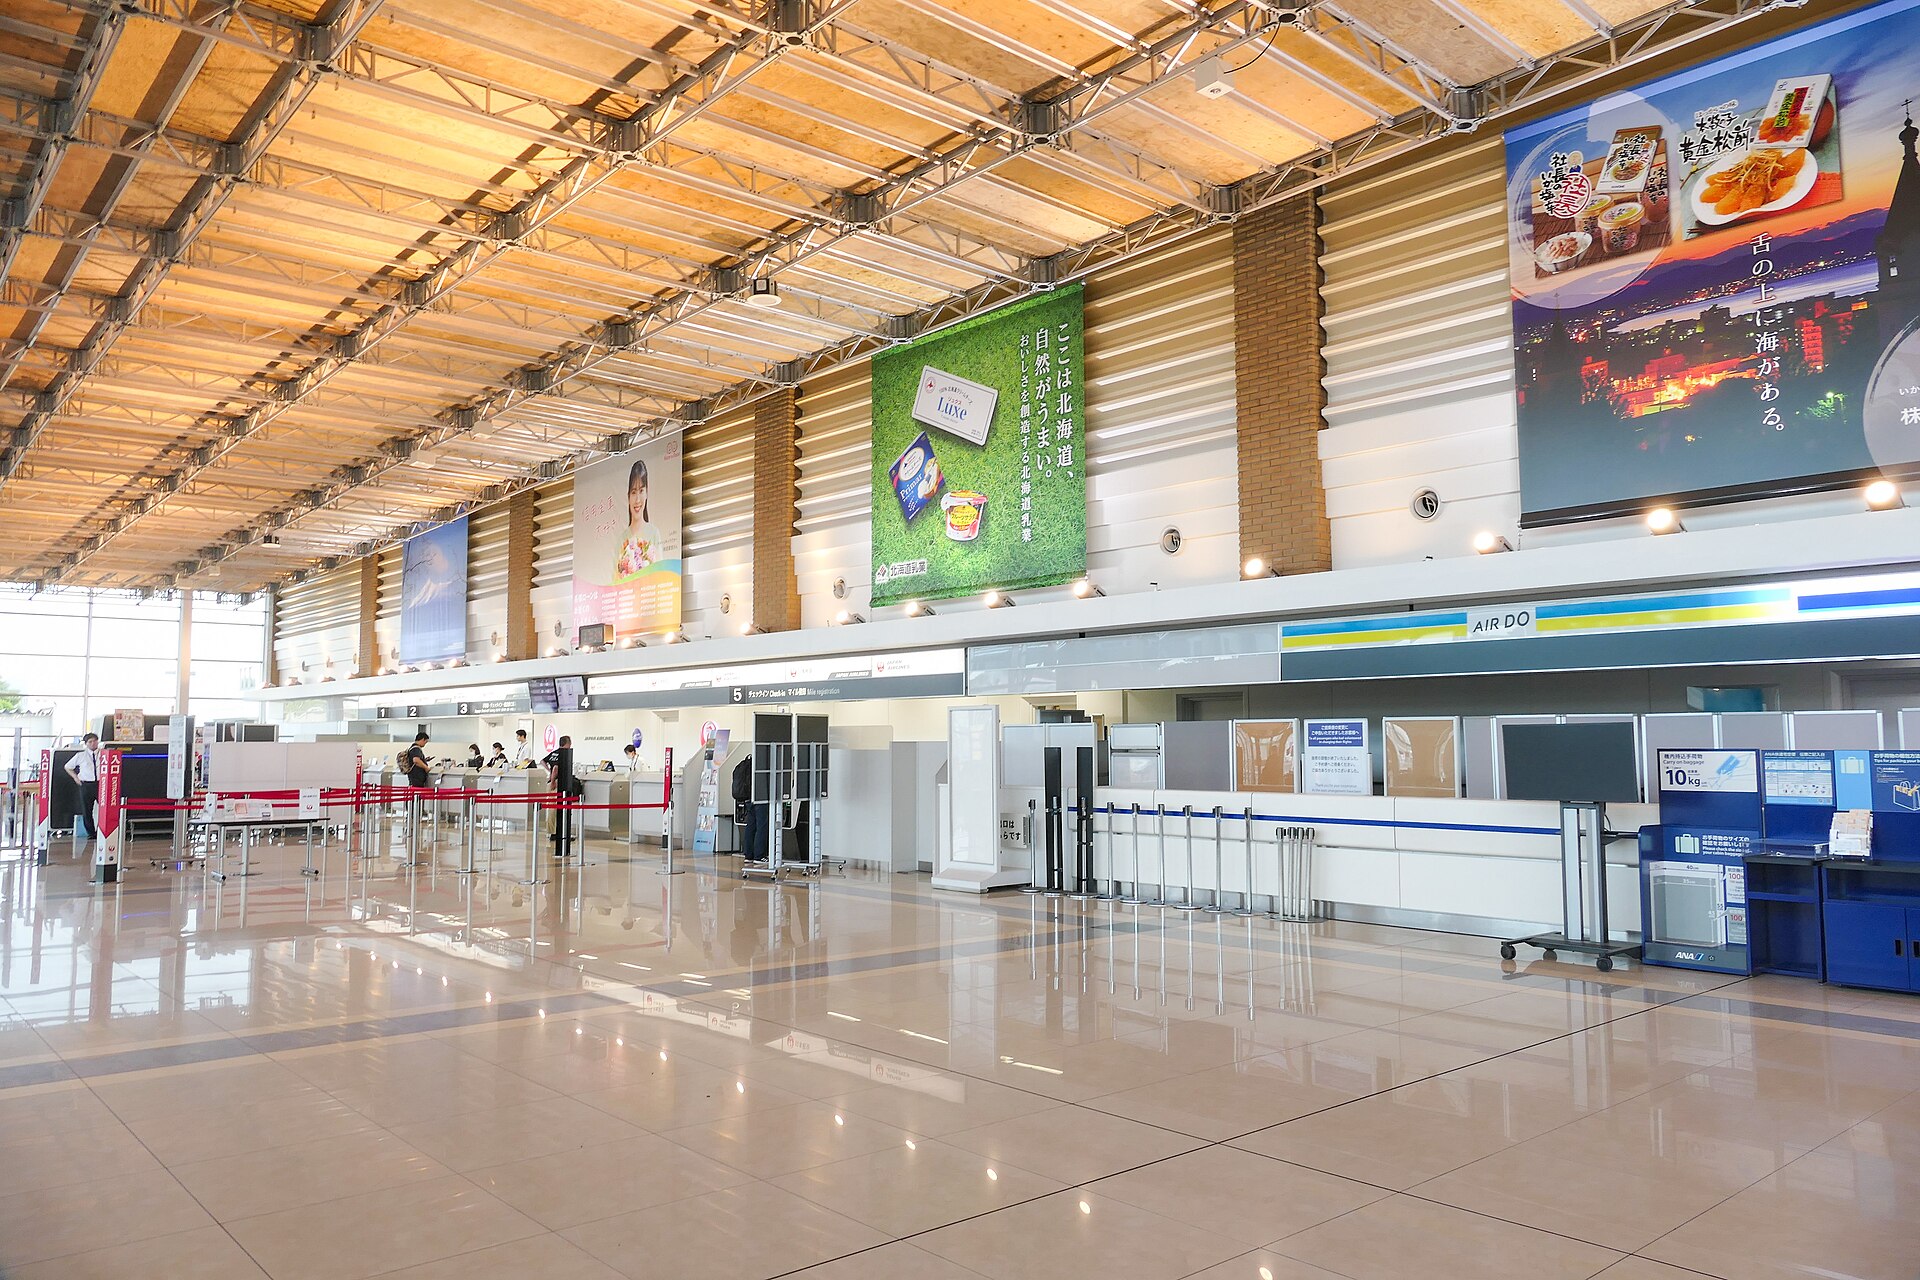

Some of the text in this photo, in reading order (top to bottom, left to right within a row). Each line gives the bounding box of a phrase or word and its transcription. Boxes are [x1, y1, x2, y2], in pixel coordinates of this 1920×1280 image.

[1550, 154, 1569, 190] 社長の
[1750, 232, 1784, 432] 舌の上に海がある。
[937, 396, 967, 420] Luxe
[1035, 328, 1052, 478] 自然がうまい。
[1056, 323, 1074, 478] ここは北海道、
[1473, 611, 1530, 632] AIR DO
[581, 696, 590, 708] 4
[733, 688, 742, 701] 5
[409, 707, 416, 717] 2
[460, 703, 468, 714] 3
[42, 753, 49, 771] 入口
[100, 754, 108, 774] 入口
[110, 754, 121, 774] 入口
[1666, 770, 1686, 785] 10
[1688, 777, 1700, 787] kg
[1000, 831, 1021, 840] らです
[1675, 952, 1694, 960] ANA
